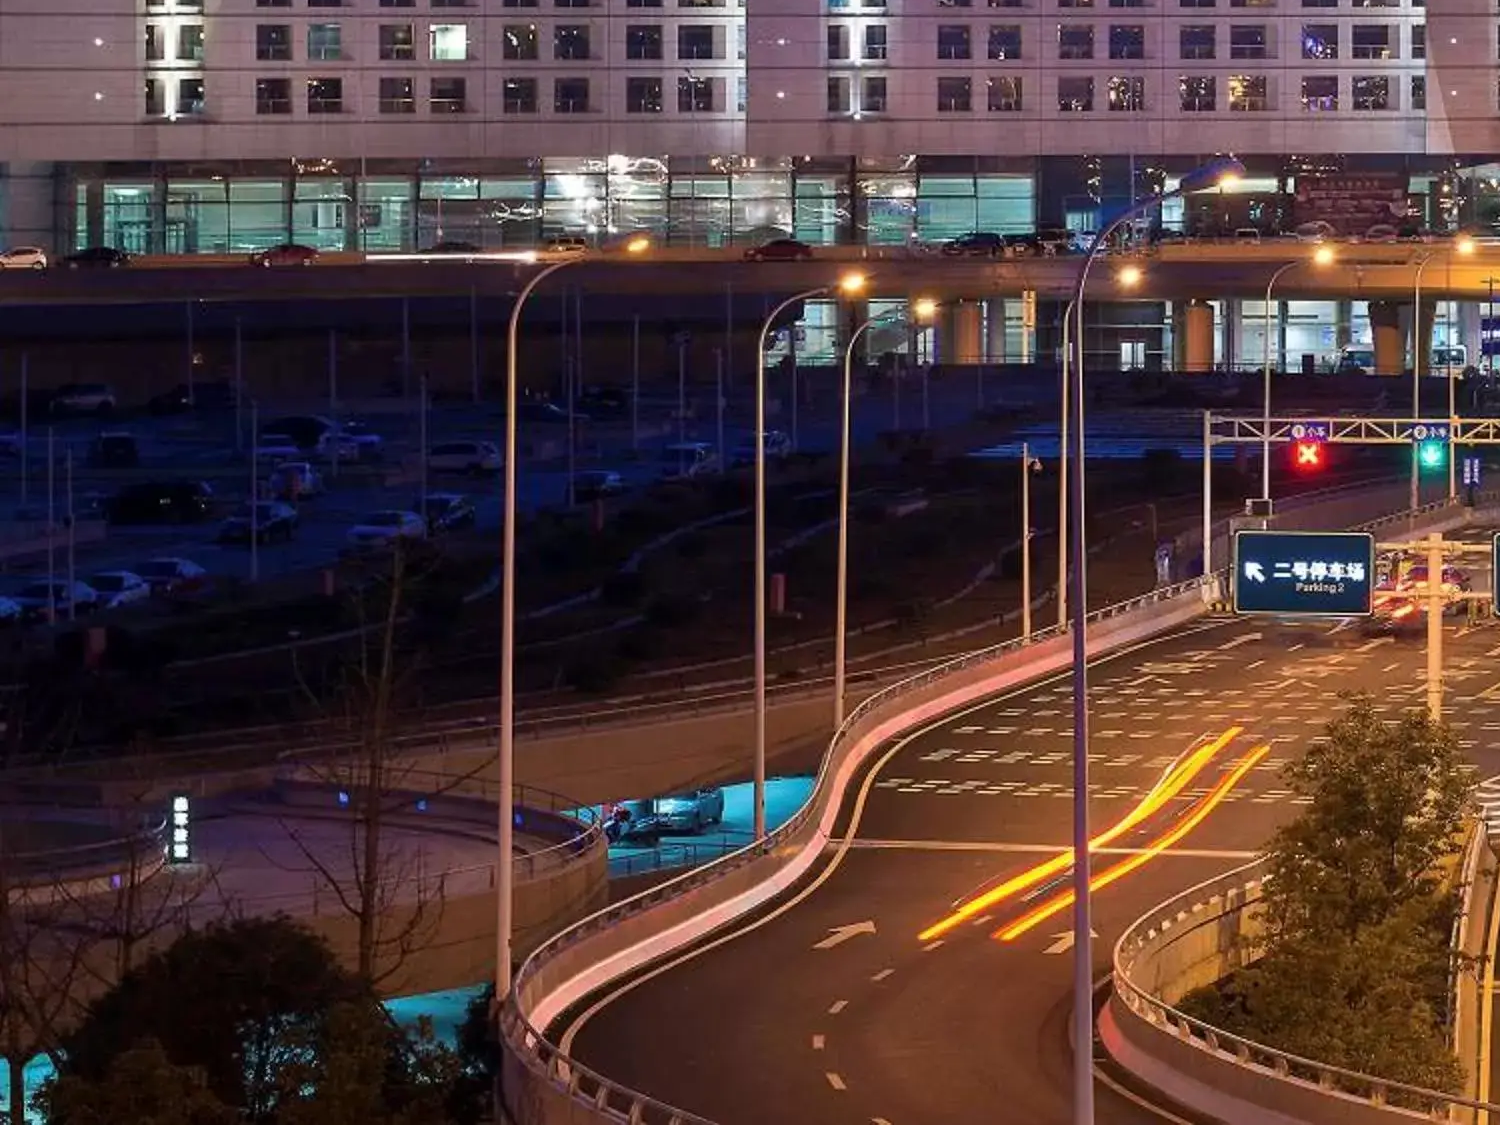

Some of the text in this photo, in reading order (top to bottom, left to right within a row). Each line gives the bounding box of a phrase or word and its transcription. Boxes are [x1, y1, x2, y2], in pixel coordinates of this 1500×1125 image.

[1274, 561, 1365, 581] 二号停车场
[1296, 582, 1345, 594] Parking 2
